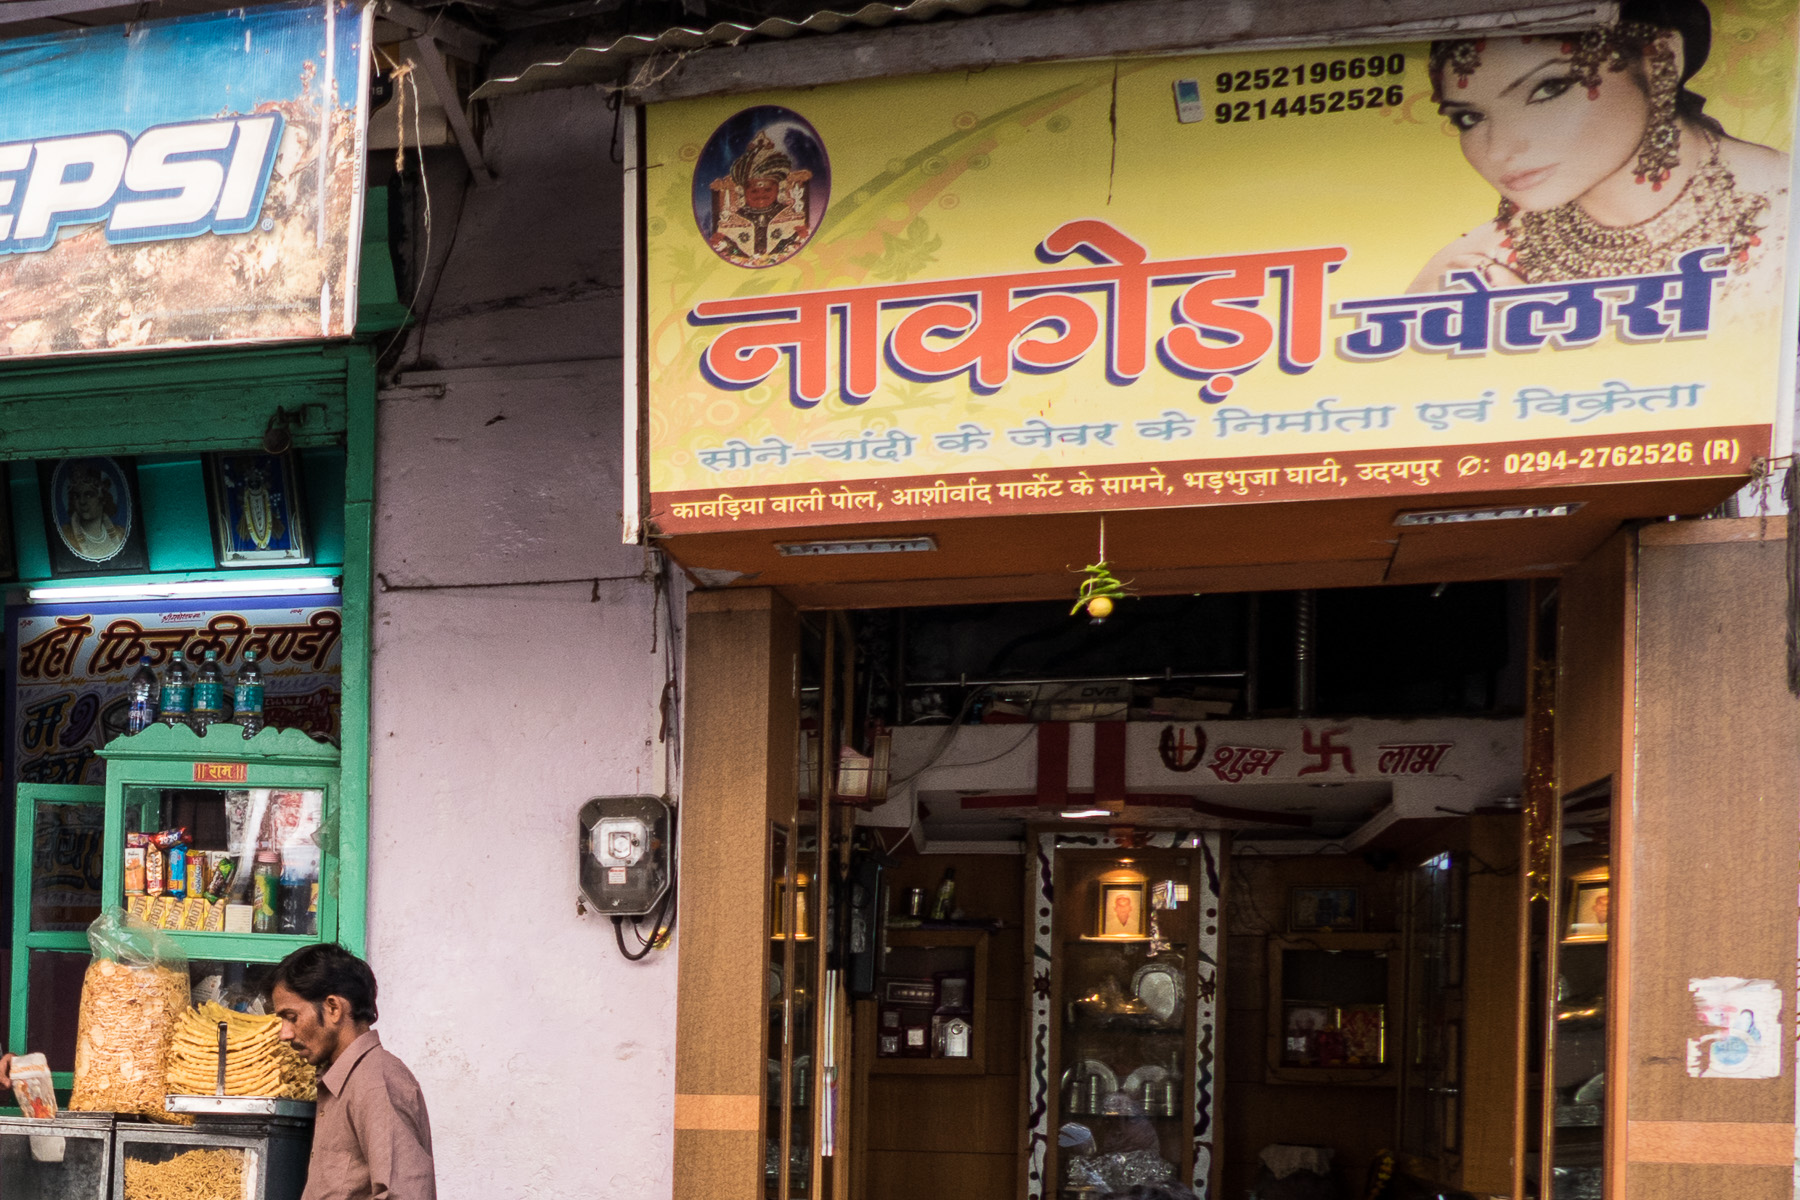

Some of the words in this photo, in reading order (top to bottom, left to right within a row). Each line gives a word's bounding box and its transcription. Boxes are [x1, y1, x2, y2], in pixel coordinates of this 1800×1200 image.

[1215, 54, 1405, 94] 9252196690
[1214, 84, 1404, 124] 9214452526
[687, 218, 1348, 410] नाकोड़ा
[1336, 246, 1729, 360] ज्वेलर्स
[699, 431, 916, 472] सोने-चांदी
[936, 424, 990, 453] के
[1009, 420, 1117, 449] जेवर
[1138, 411, 1195, 441] के
[1214, 398, 1395, 438] निर्माता
[1417, 391, 1494, 431] एवं
[1513, 382, 1704, 423] विक्रेता
[671, 493, 763, 523] कावड़िया
[771, 491, 824, 514] वाली
[830, 486, 884, 512] पोल,
[891, 478, 991, 508] आशीर्वाद
[997, 473, 1063, 500] मार्केट
[1069, 471, 1094, 496] के
[1100, 466, 1173, 495] सामने,
[1182, 464, 1278, 497] भड़भुजा
[1284, 457, 1348, 487] घाटी,
[1357, 459, 1442, 487] उदयपुर
[1504, 441, 1692, 475] 0294-2762526
[1702, 439, 1740, 465] (R)
[209, 764, 232, 779] राम
[1207, 743, 1286, 783] शुभ
[1376, 742, 1454, 775] लाभ
